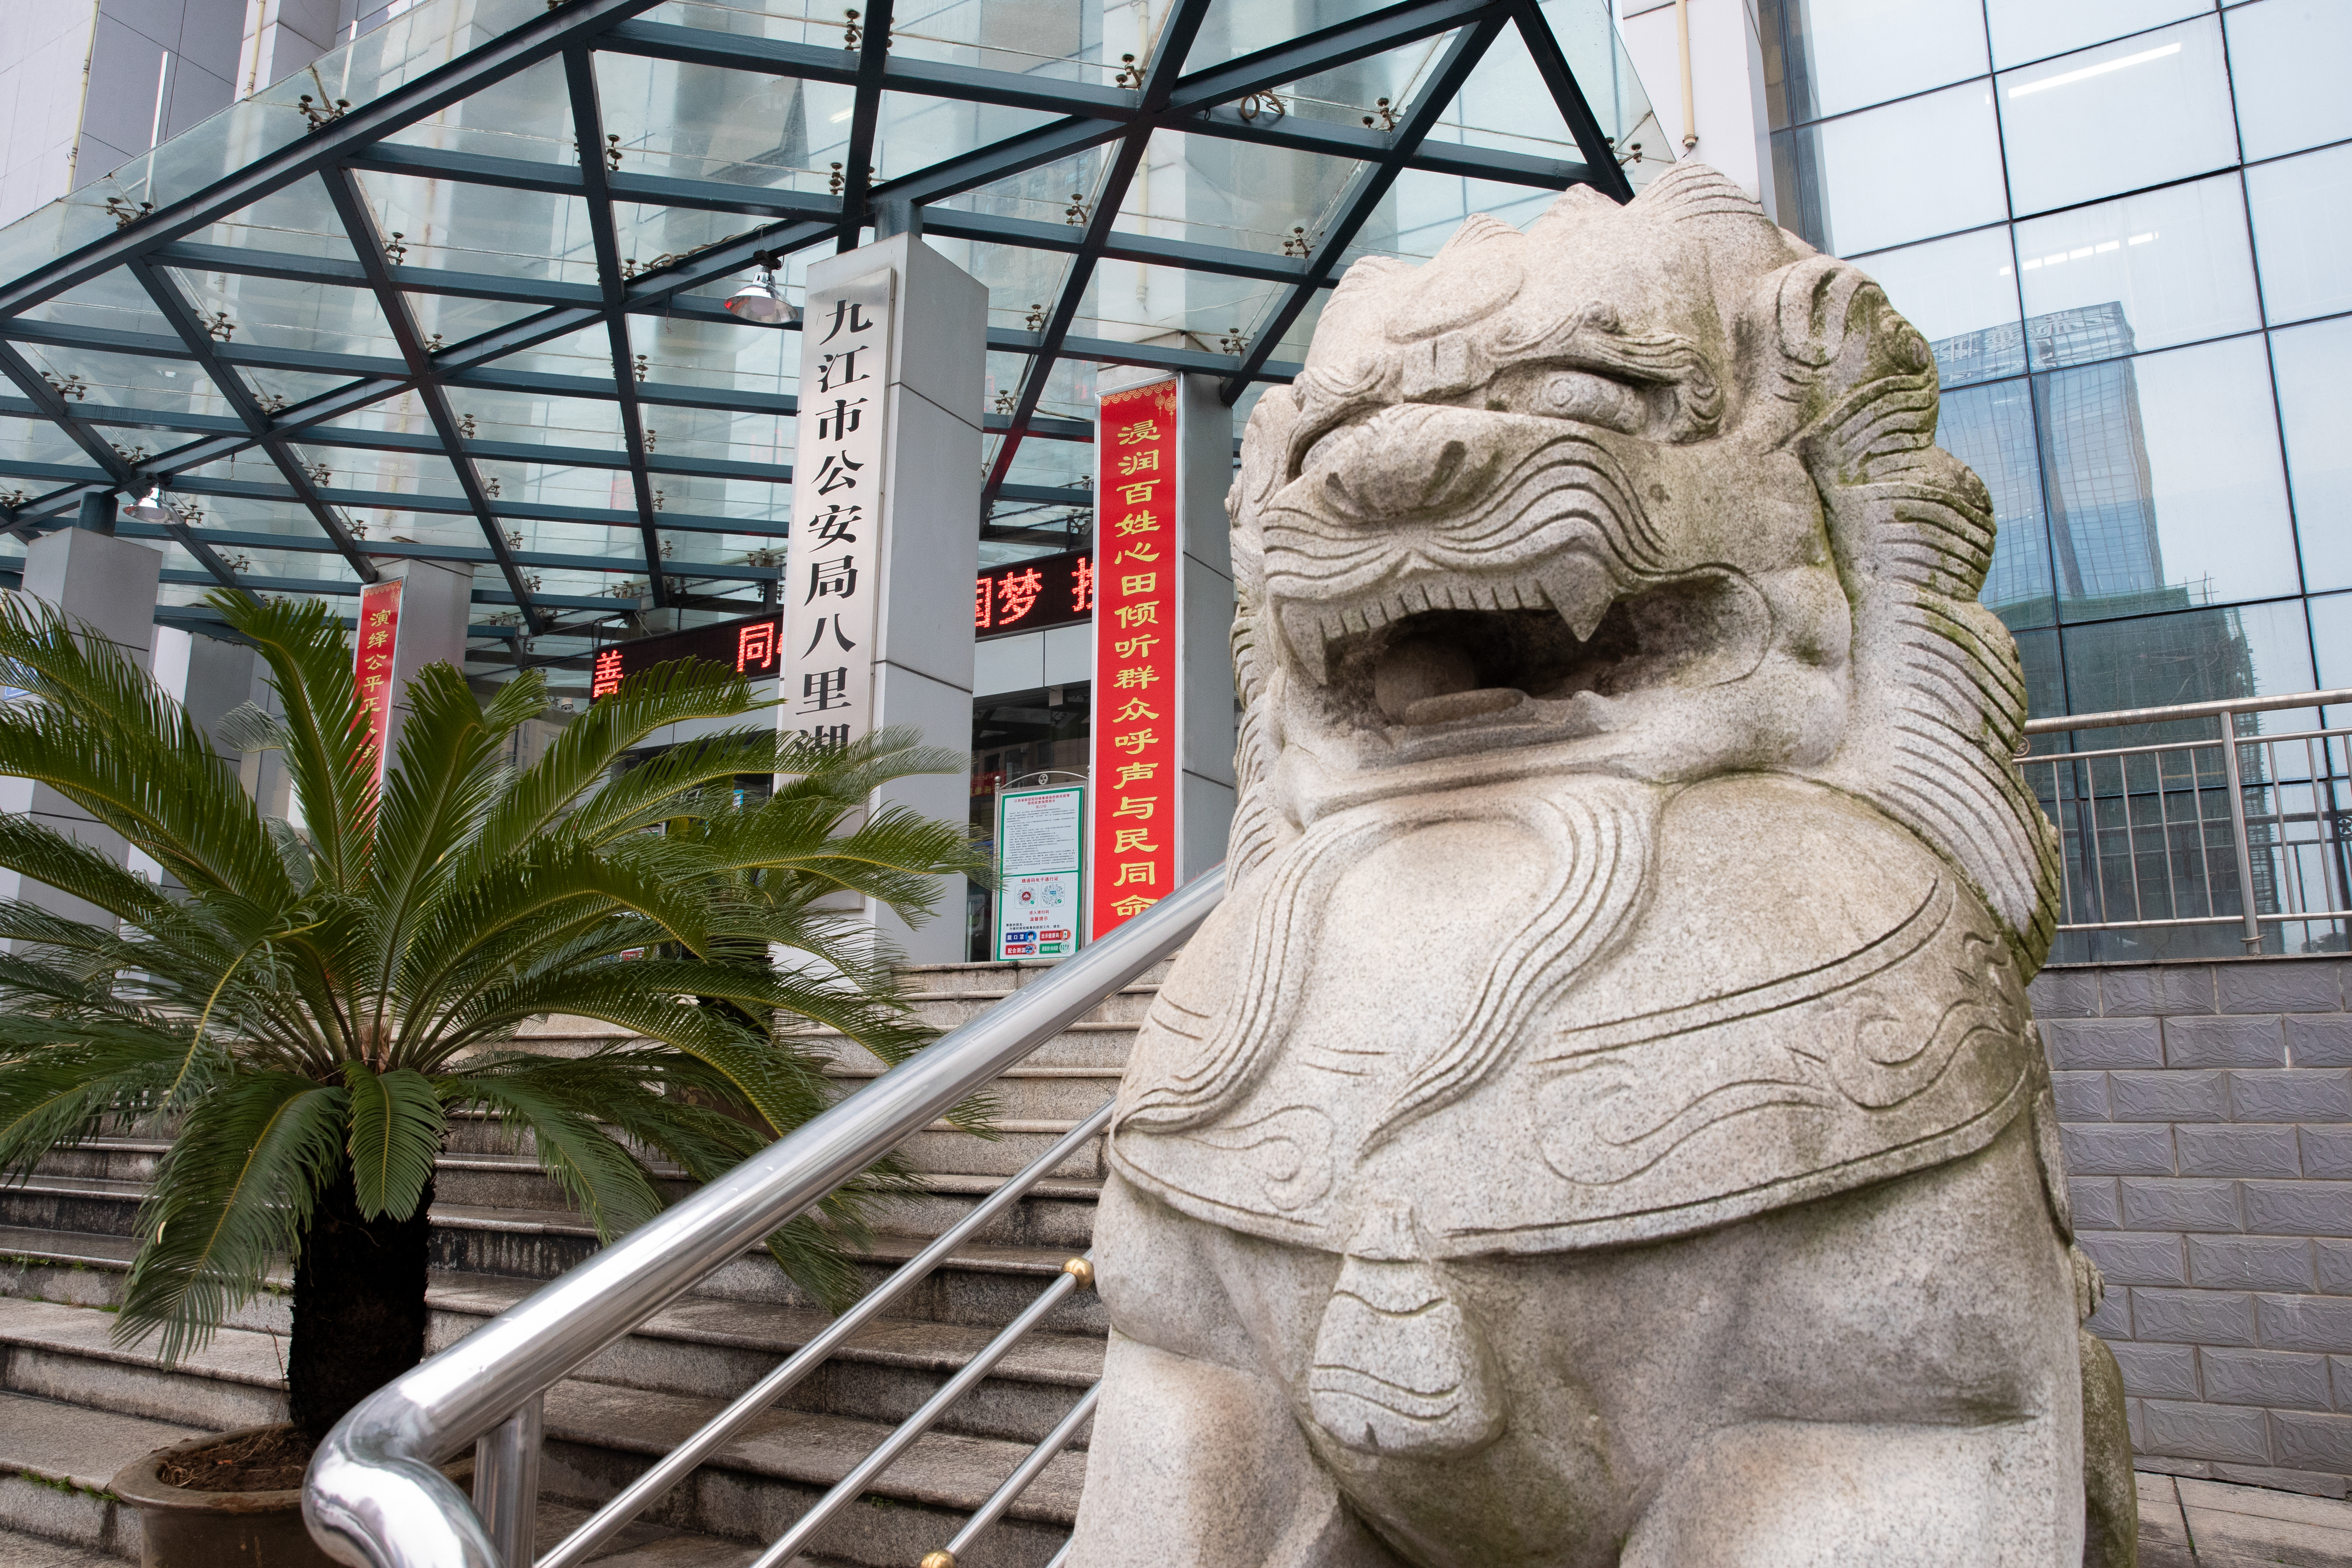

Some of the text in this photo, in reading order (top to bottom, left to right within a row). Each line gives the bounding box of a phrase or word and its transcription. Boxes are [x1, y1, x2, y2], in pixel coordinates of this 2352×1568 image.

[737, 622, 783, 672] 同
[795, 300, 873, 760] 九江市公安局八里湖
[1111, 419, 1161, 916] 浸润百姓心田倾听群众呼声与民同命
